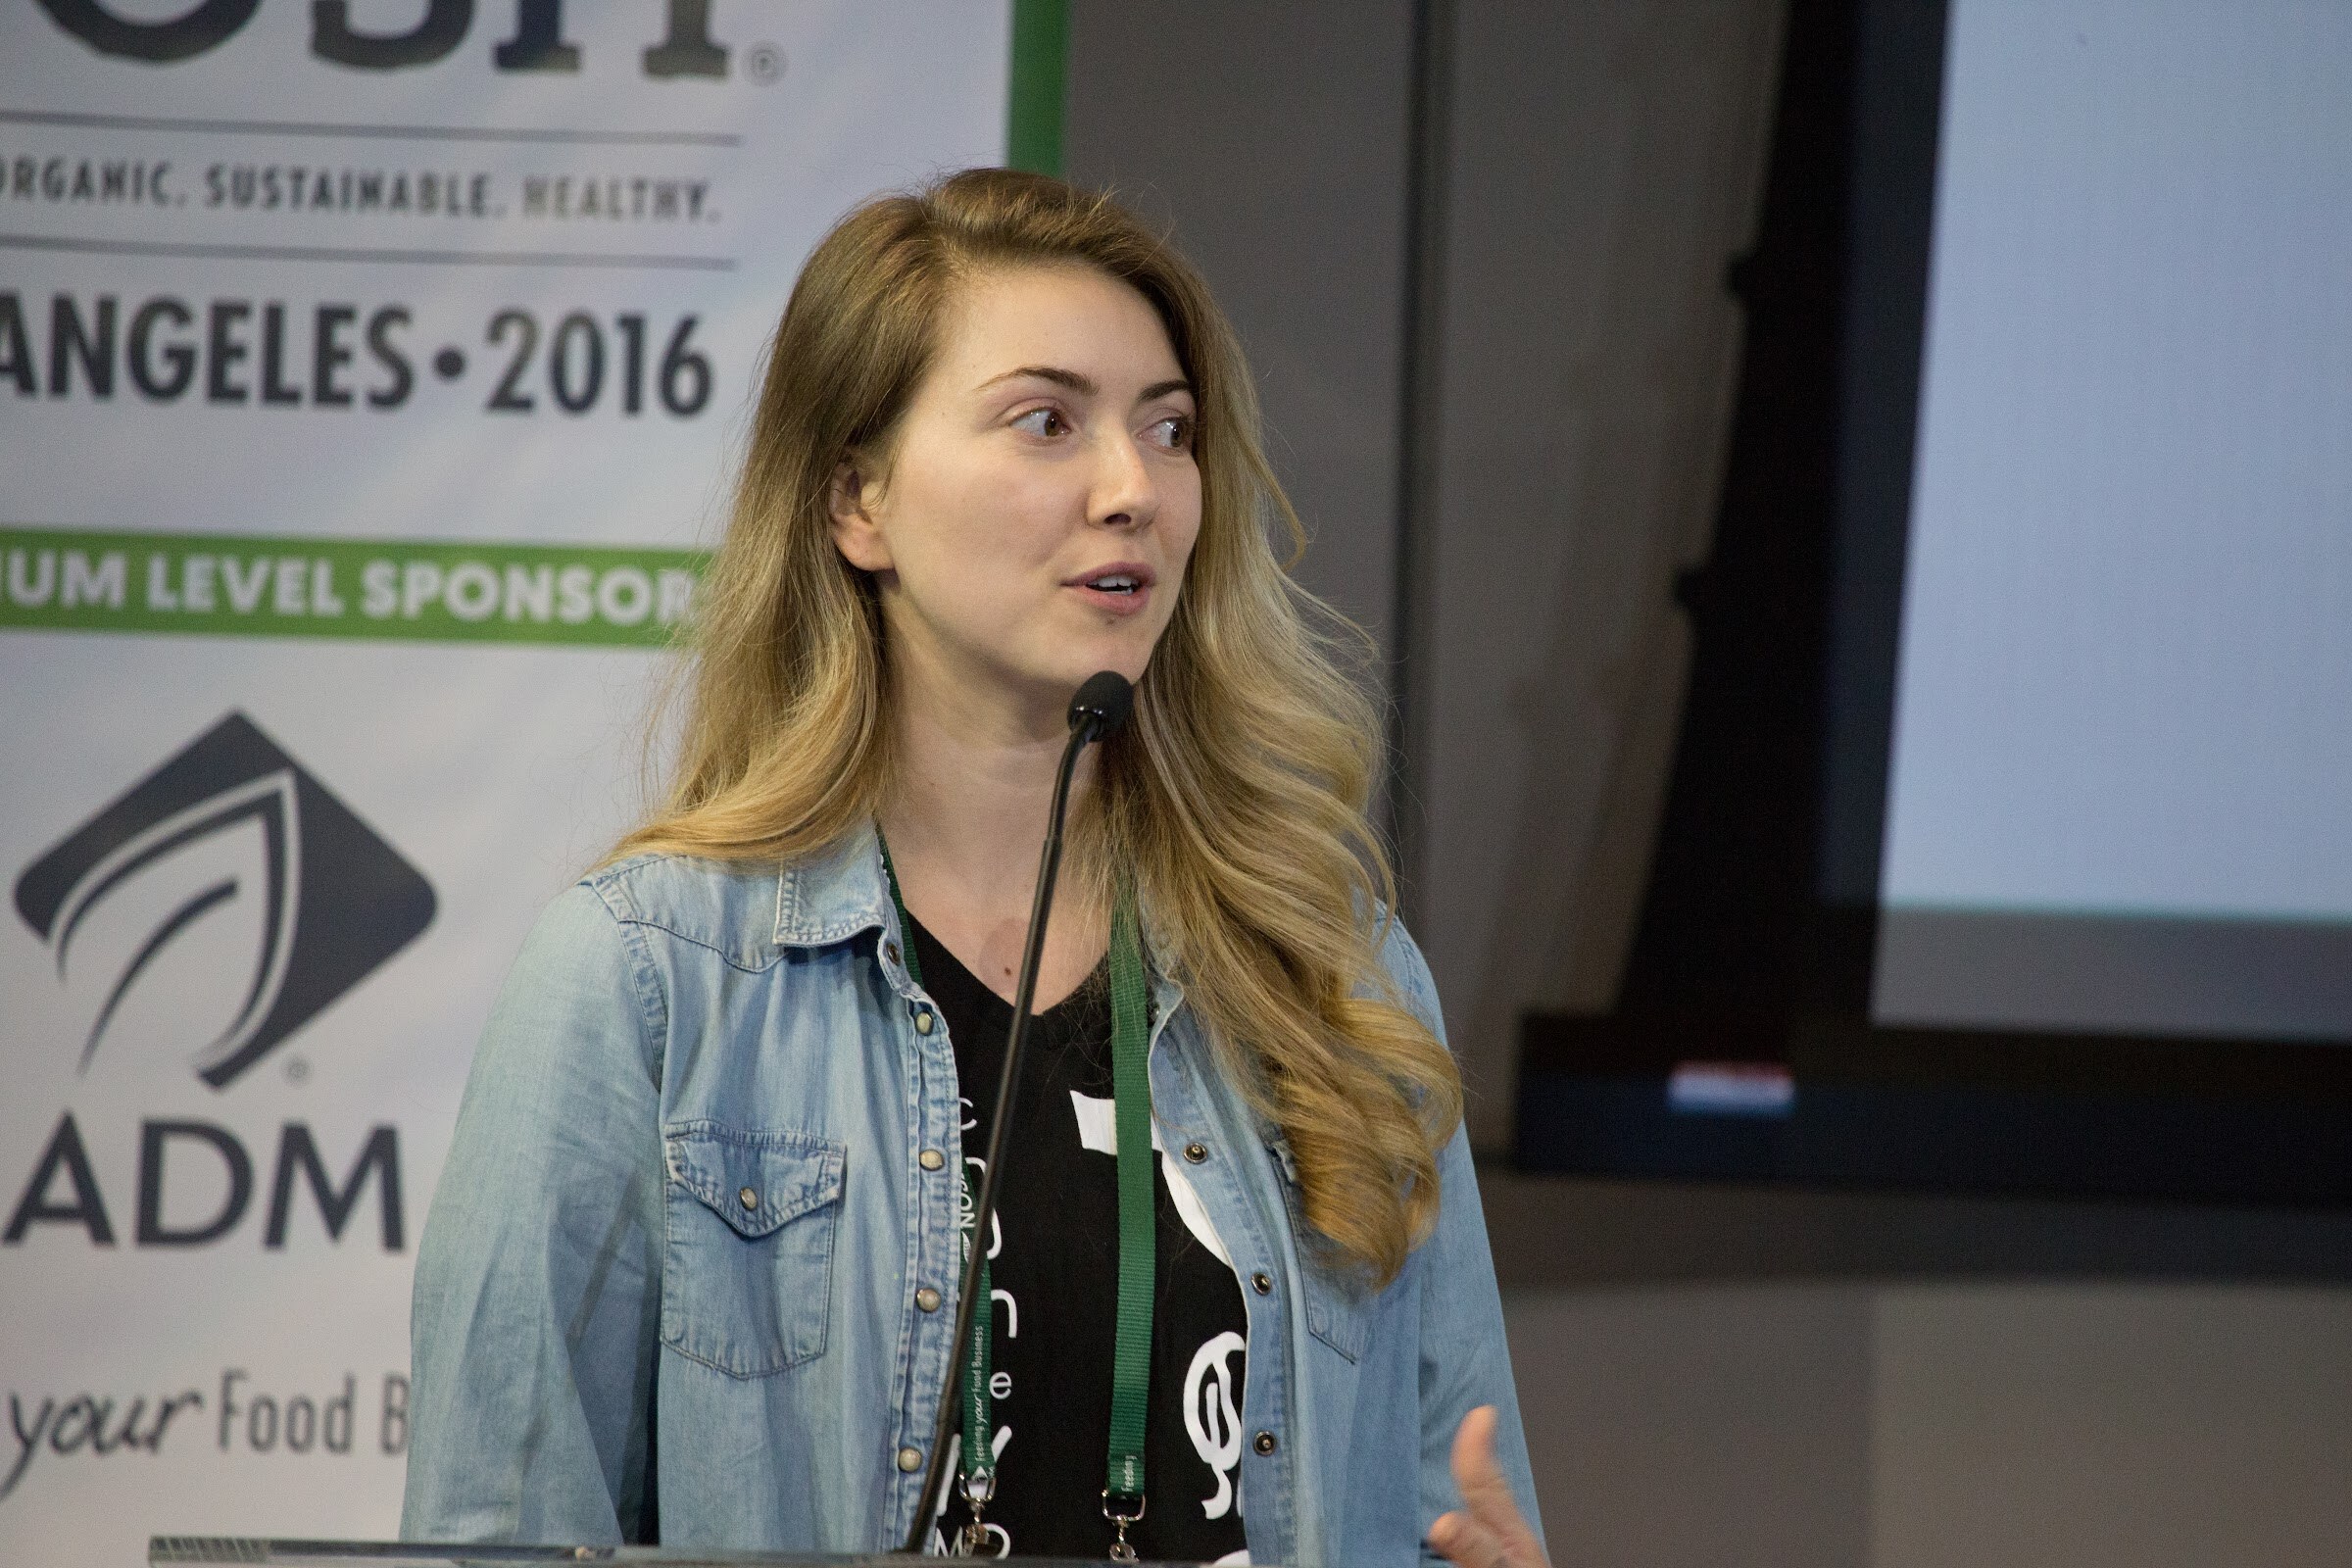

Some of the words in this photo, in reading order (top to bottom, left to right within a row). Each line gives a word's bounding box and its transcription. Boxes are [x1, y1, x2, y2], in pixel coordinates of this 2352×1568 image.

[0, 154, 187, 207] RGANIC.
[204, 162, 508, 220] SUSTAINABLE.
[522, 174, 721, 224] HEALTHY.
[147, 554, 345, 616] LEVEL
[2, 1108, 407, 1254] ADM
[971, 1325, 984, 1366] Business
[0, 1390, 204, 1501] your
[218, 1368, 356, 1454] Food
[974, 1393, 989, 1424] your
